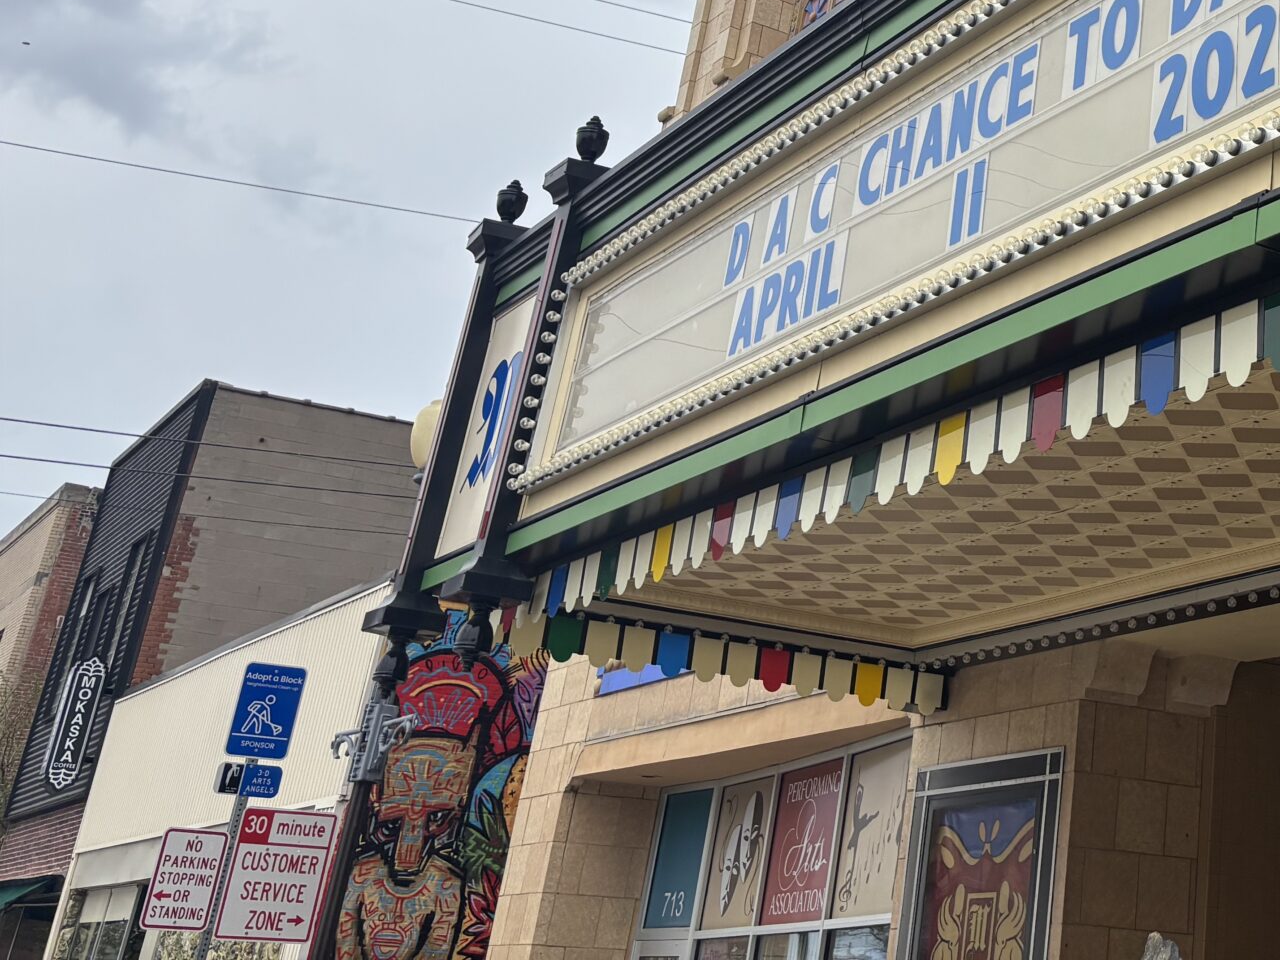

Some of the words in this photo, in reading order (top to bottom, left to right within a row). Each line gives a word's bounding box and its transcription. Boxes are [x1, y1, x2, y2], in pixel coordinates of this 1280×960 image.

[724, 221, 750, 287] D
[763, 194, 789, 264] A
[810, 164, 839, 234] C
[858, 43, 1038, 206] CHANCE
[728, 240, 839, 357] APRIL
[246, 672, 272, 683] Adopt
[280, 675, 303, 685] Block
[60, 675, 96, 762] MOKASKA
[240, 740, 275, 749] SPONSOR
[53, 761, 76, 769] COFFEE
[245, 785, 274, 793] ANGELS
[252, 777, 271, 785] ARTS
[786, 770, 843, 804] PERFORMING
[245, 815, 268, 833] 30
[276, 818, 326, 838] minute
[185, 840, 203, 853] NO
[778, 798, 827, 890] Arts
[162, 854, 217, 871] PARKING
[241, 851, 319, 875] CUSTOMER
[158, 871, 213, 887] STOPPING
[172, 889, 190, 903] OR
[240, 881, 307, 904] SERVICE
[768, 887, 827, 916] ASSOCIATION
[150, 905, 204, 921] STANDING
[661, 891, 685, 918] 713
[244, 910, 286, 931] ZONE
